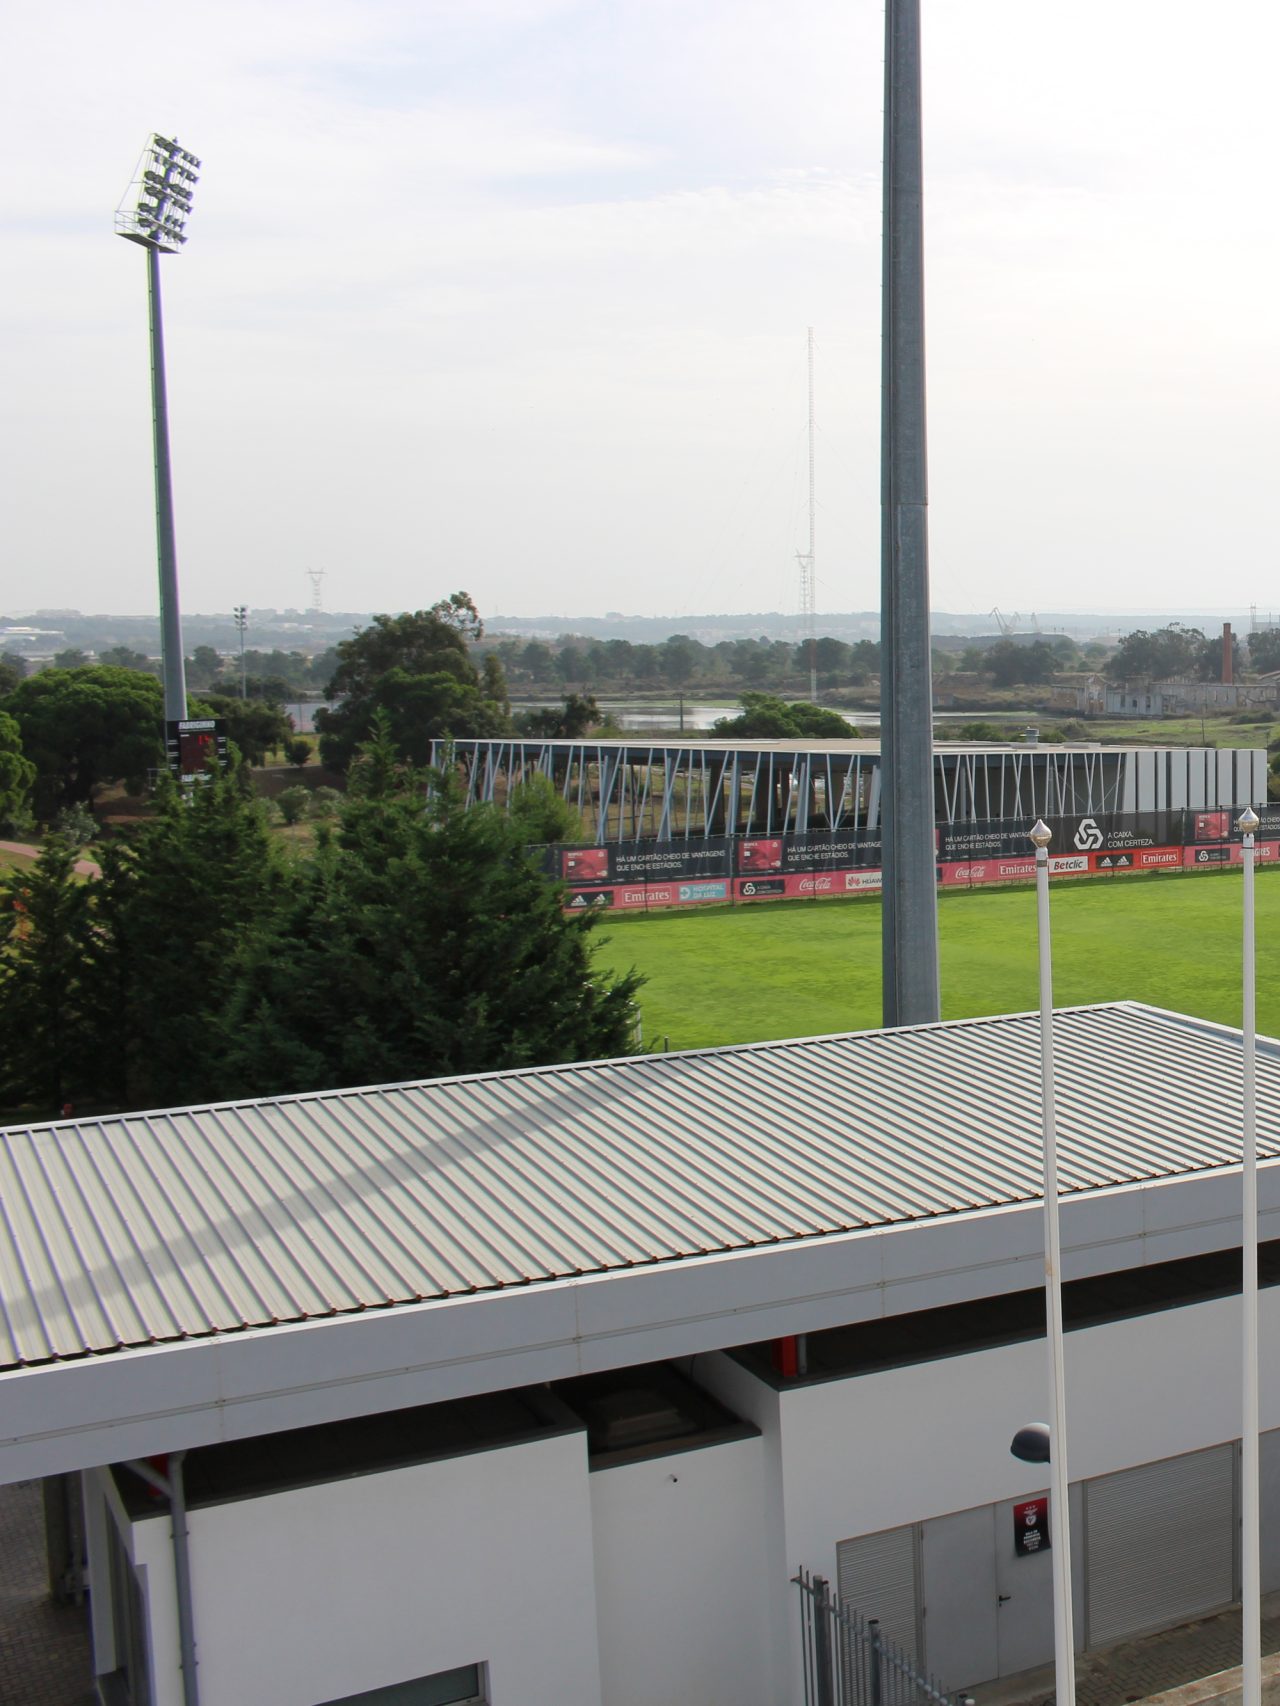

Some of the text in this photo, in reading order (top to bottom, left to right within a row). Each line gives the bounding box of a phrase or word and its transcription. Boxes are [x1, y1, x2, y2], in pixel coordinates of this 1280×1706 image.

[1107, 840, 1123, 848] COM
[787, 845, 796, 853] HÁ
[616, 855, 626, 863] HÁ
[626, 855, 637, 863] UM
[1142, 853, 1177, 864] Emirates
[616, 864, 630, 872] QUE
[1054, 859, 1083, 870] Betclic
[1000, 864, 1037, 875] Emirates
[624, 890, 670, 903] Emirates
